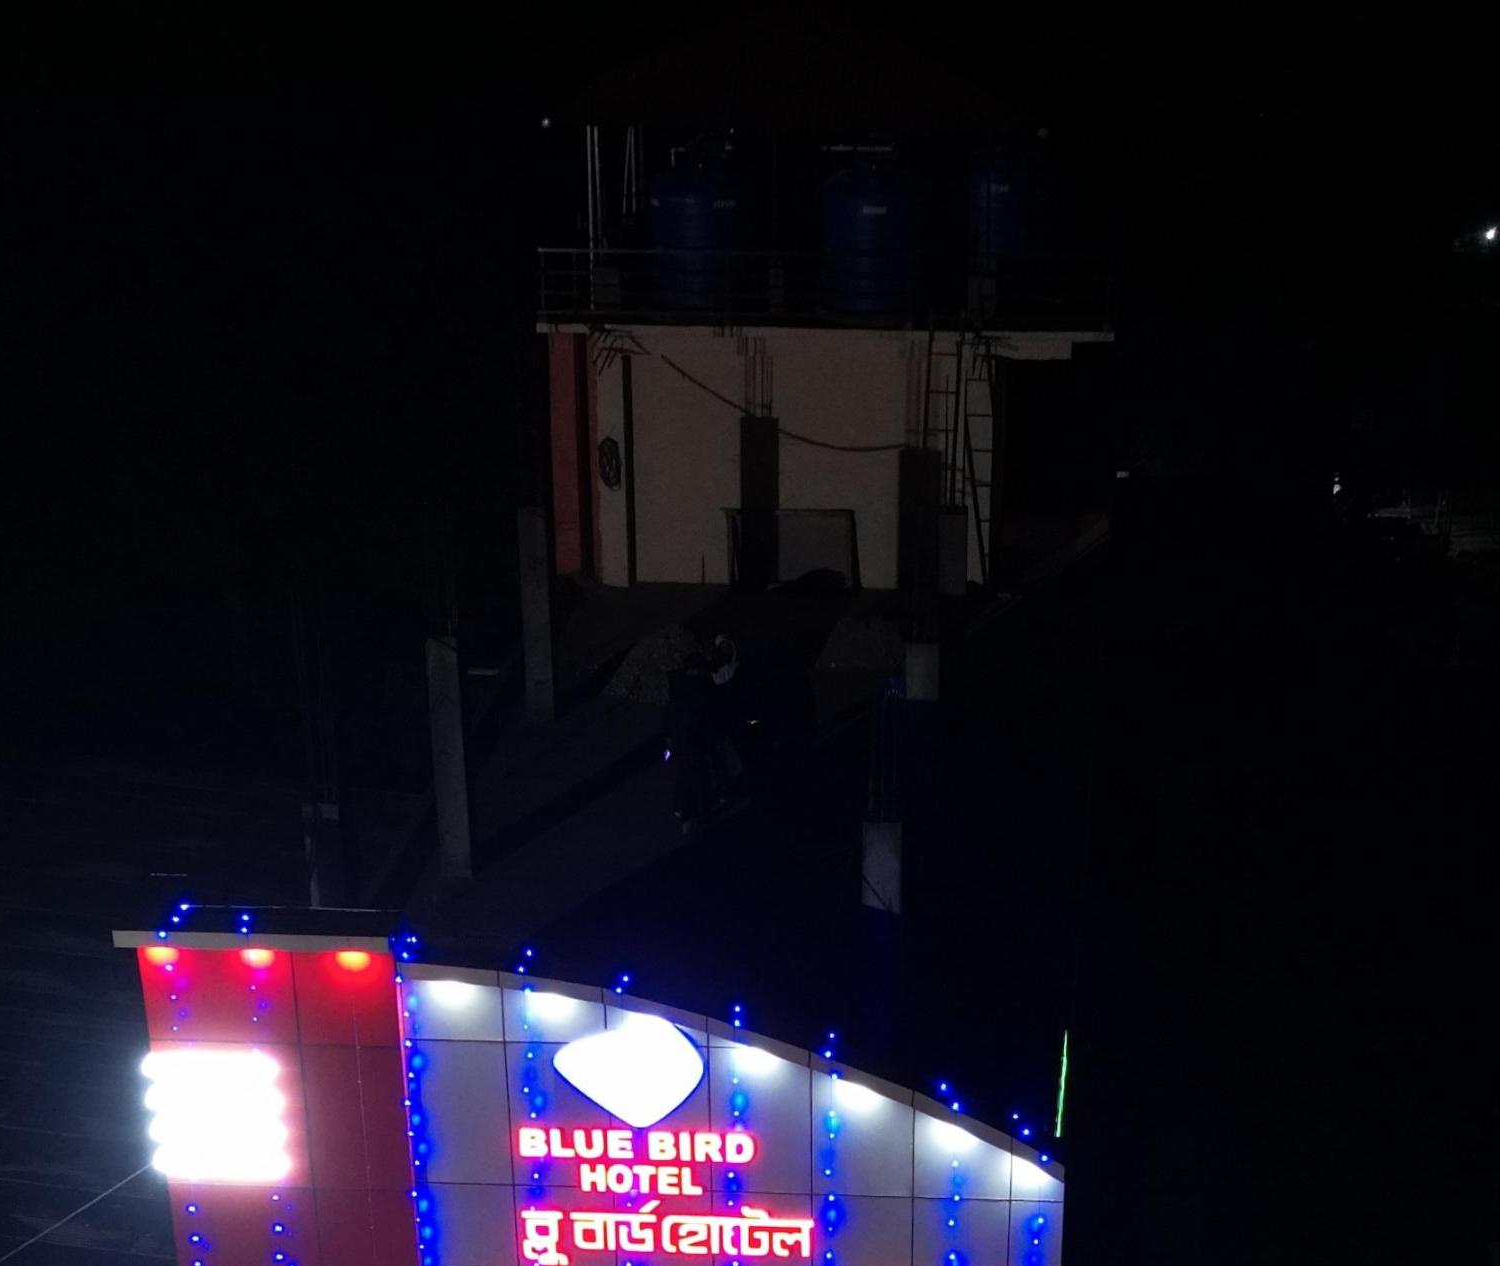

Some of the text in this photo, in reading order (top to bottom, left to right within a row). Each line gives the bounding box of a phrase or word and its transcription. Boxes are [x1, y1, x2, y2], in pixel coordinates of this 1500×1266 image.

[519, 1127, 755, 1163] BLUE BIRD
[580, 1164, 703, 1196] HOTEL
[569, 1200, 660, 1252] বার্ড
[661, 1206, 815, 1257] হোটেল
